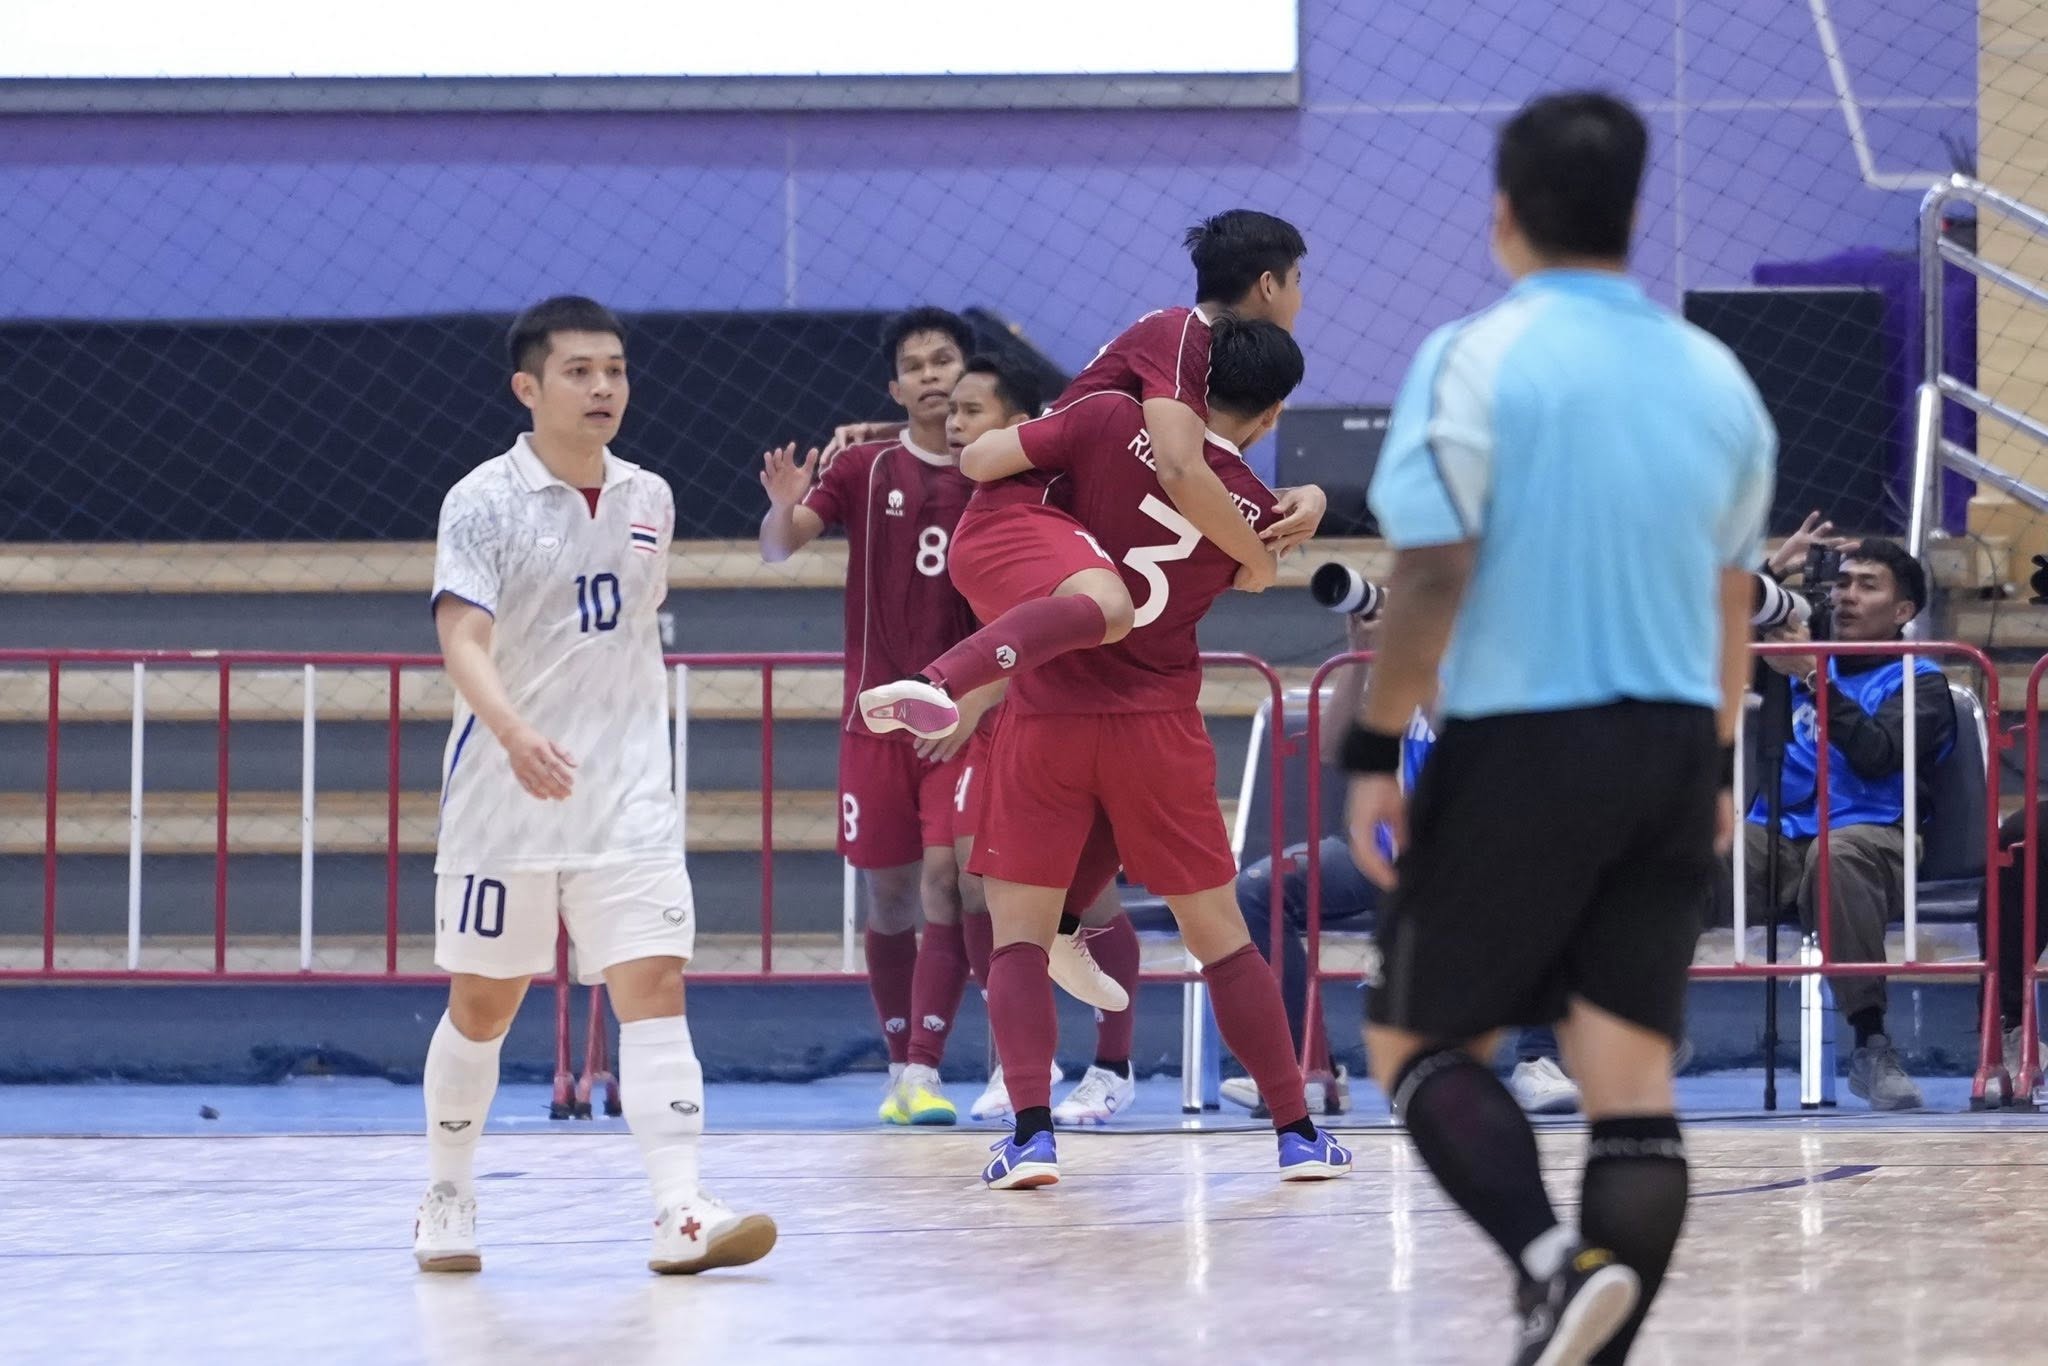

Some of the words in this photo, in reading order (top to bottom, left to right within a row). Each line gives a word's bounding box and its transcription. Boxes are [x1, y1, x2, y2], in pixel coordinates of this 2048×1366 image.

[915, 526, 948, 577] 8
[1122, 493, 1203, 628] 3
[575, 573, 621, 632] 10
[459, 874, 506, 938] 10
